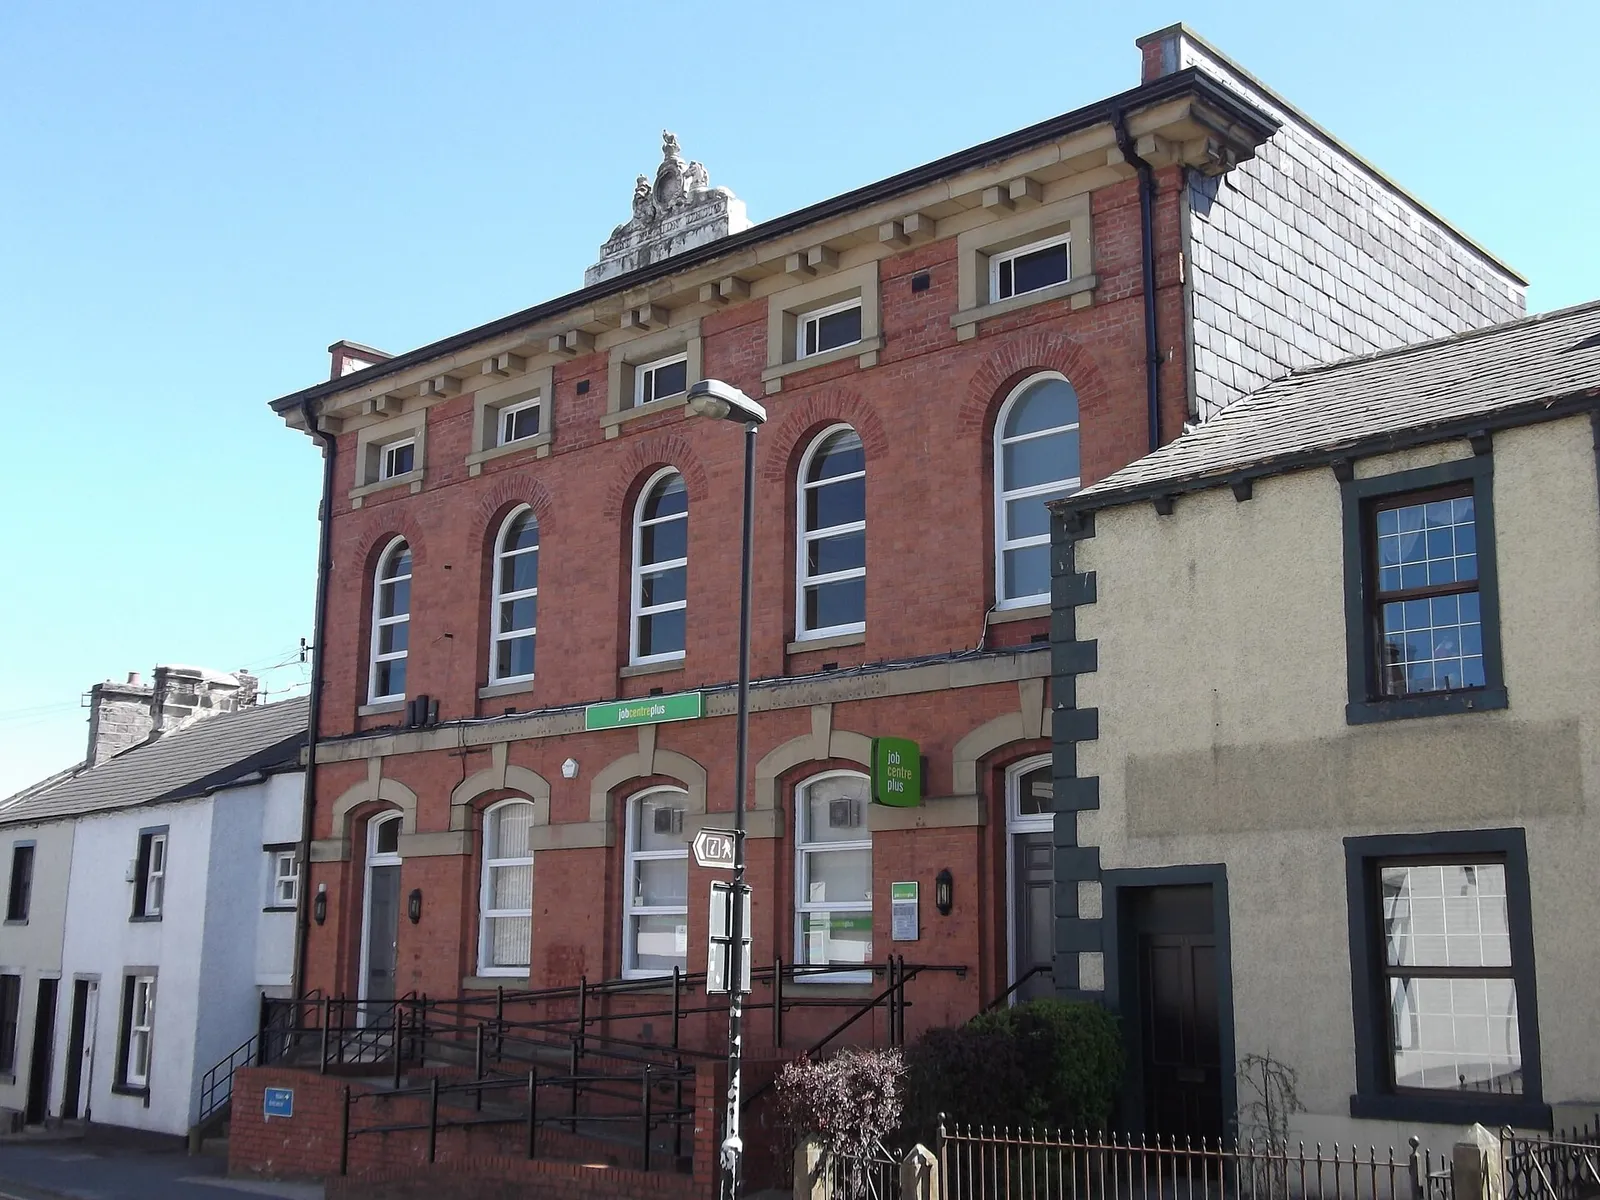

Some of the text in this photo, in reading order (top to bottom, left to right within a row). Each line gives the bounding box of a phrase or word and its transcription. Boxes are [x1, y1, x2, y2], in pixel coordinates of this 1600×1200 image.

[618, 703, 665, 721] jobcentreplus
[887, 749, 900, 765] job
[887, 766, 912, 780] centre
[887, 778, 904, 793] plus
